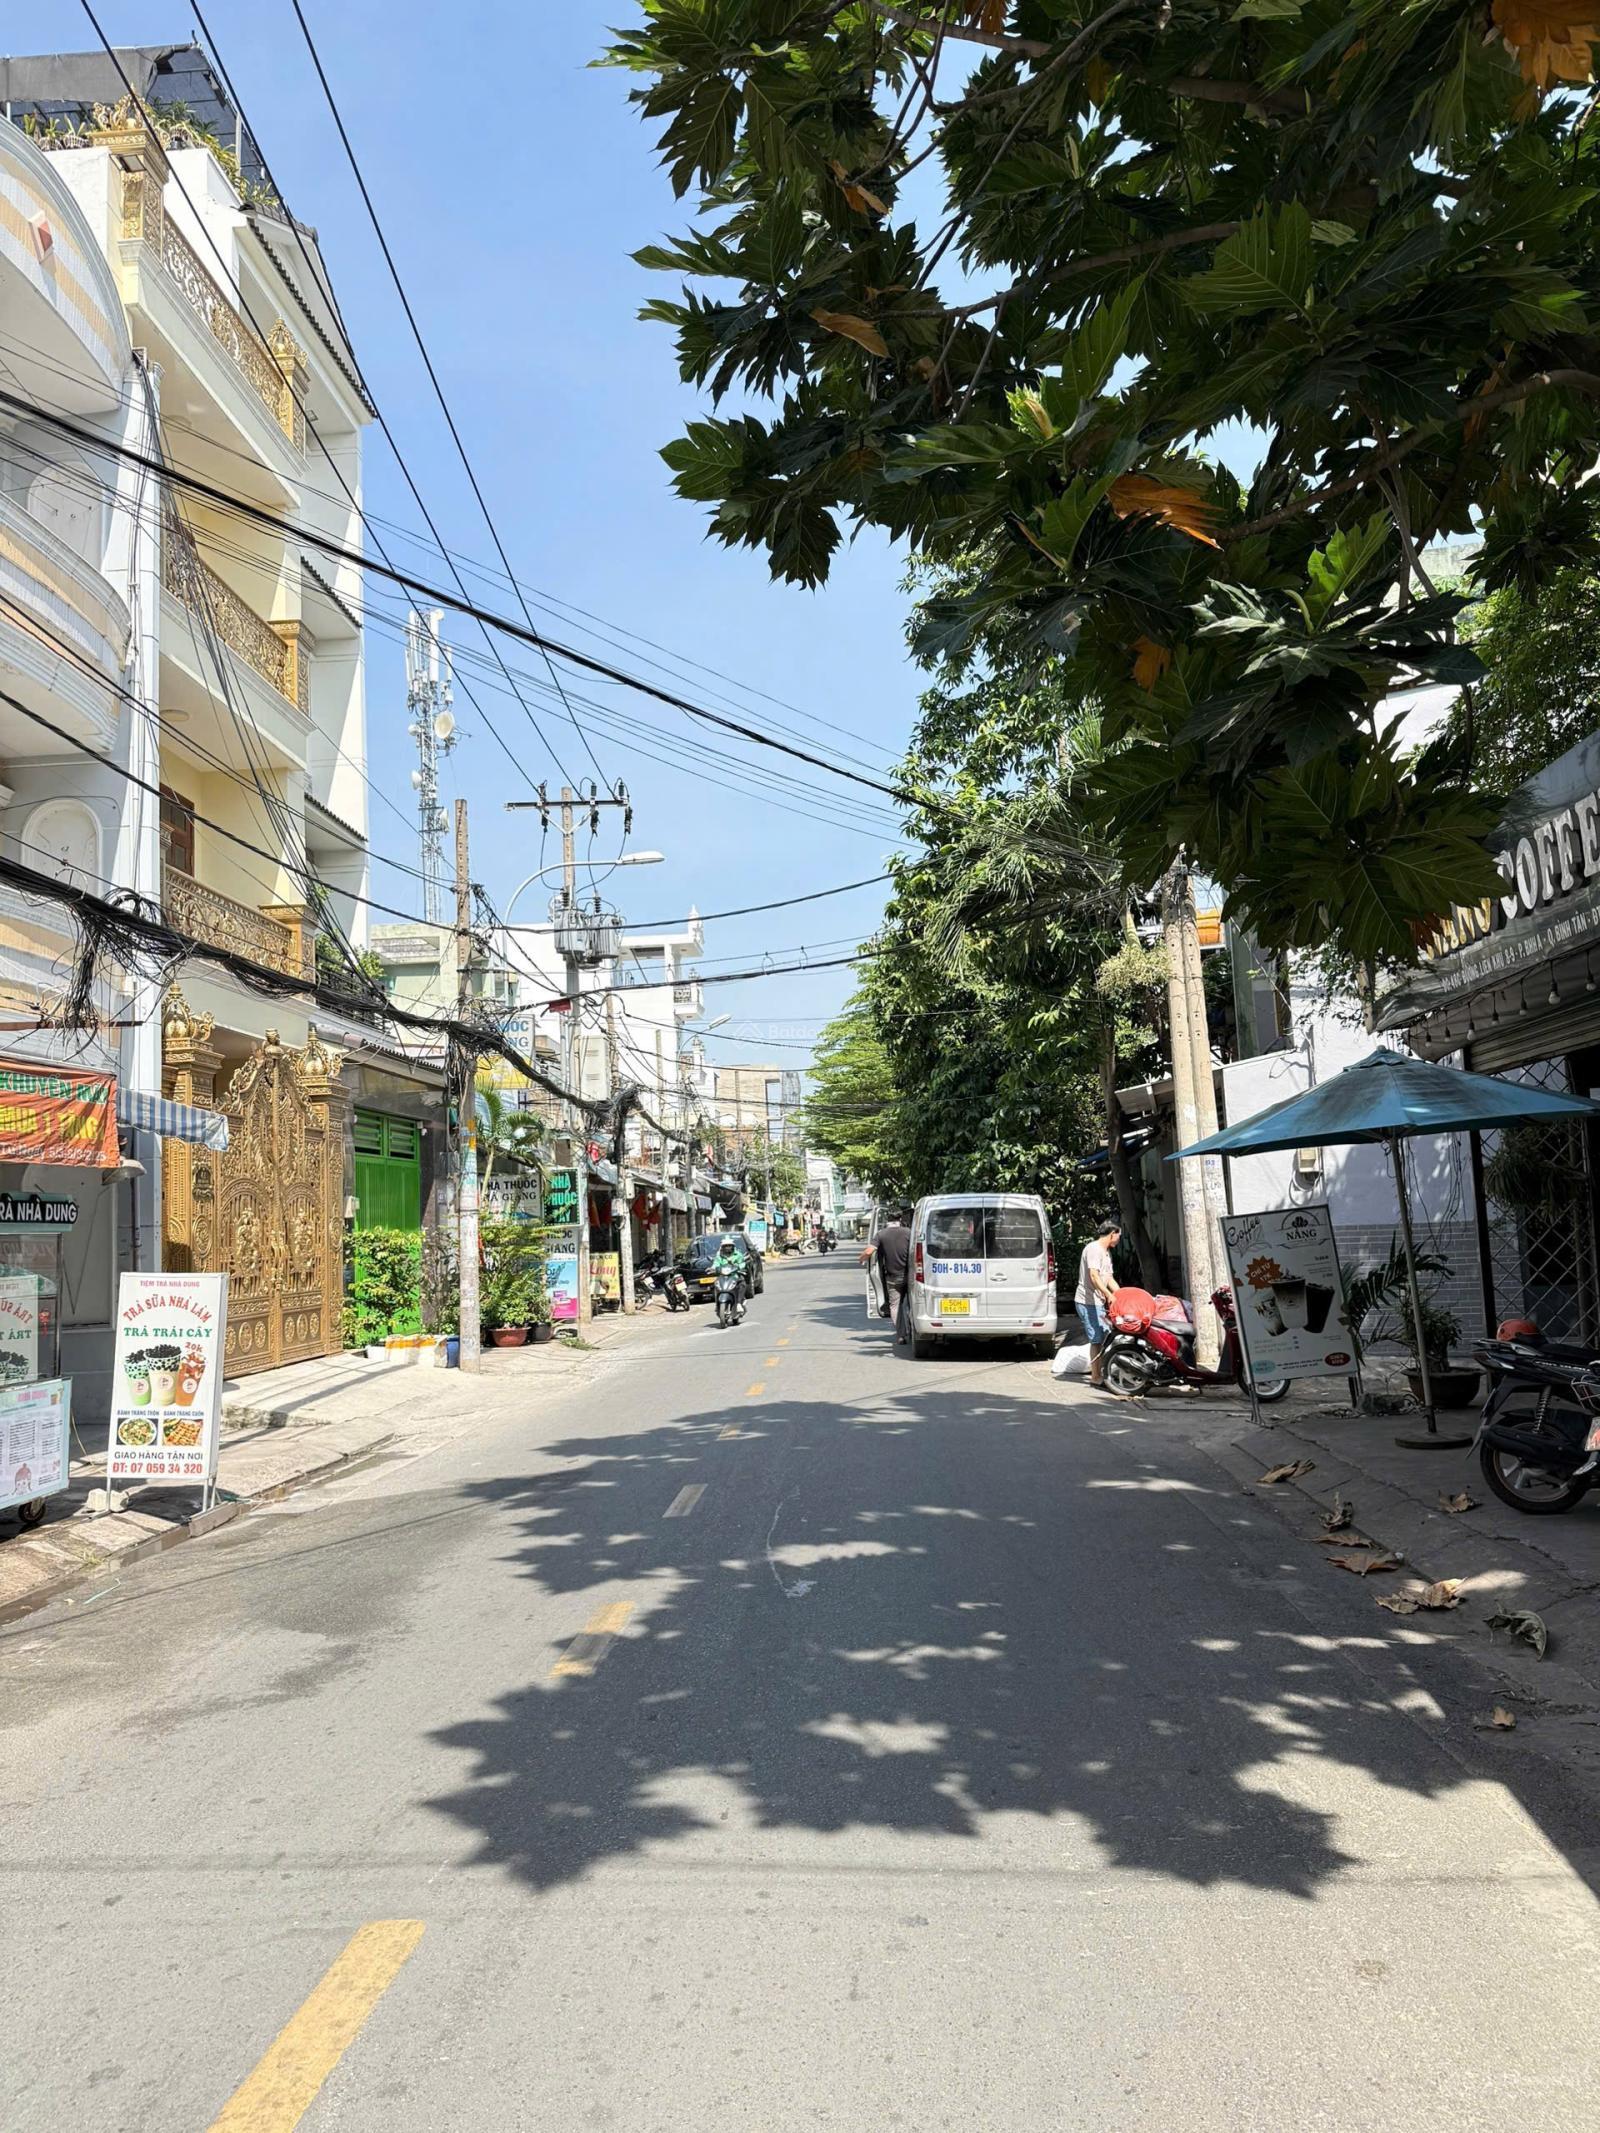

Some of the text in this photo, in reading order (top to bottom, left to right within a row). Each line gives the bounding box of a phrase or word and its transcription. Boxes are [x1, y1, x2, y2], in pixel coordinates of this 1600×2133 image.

[1493, 787, 1600, 920] COFFE
[17, 1198, 42, 1220] NHÀ
[45, 1203, 77, 1222] DUNG
[145, 1293, 166, 1310] SỮA
[114, 1452, 136, 1460] GIAO
[138, 1450, 164, 1460] HÀNG
[167, 1451, 185, 1462] TẬN
[130, 1463, 143, 1473] 07
[146, 1463, 165, 1474] 059
[168, 1464, 180, 1474] 34
[184, 1464, 203, 1474] 320
